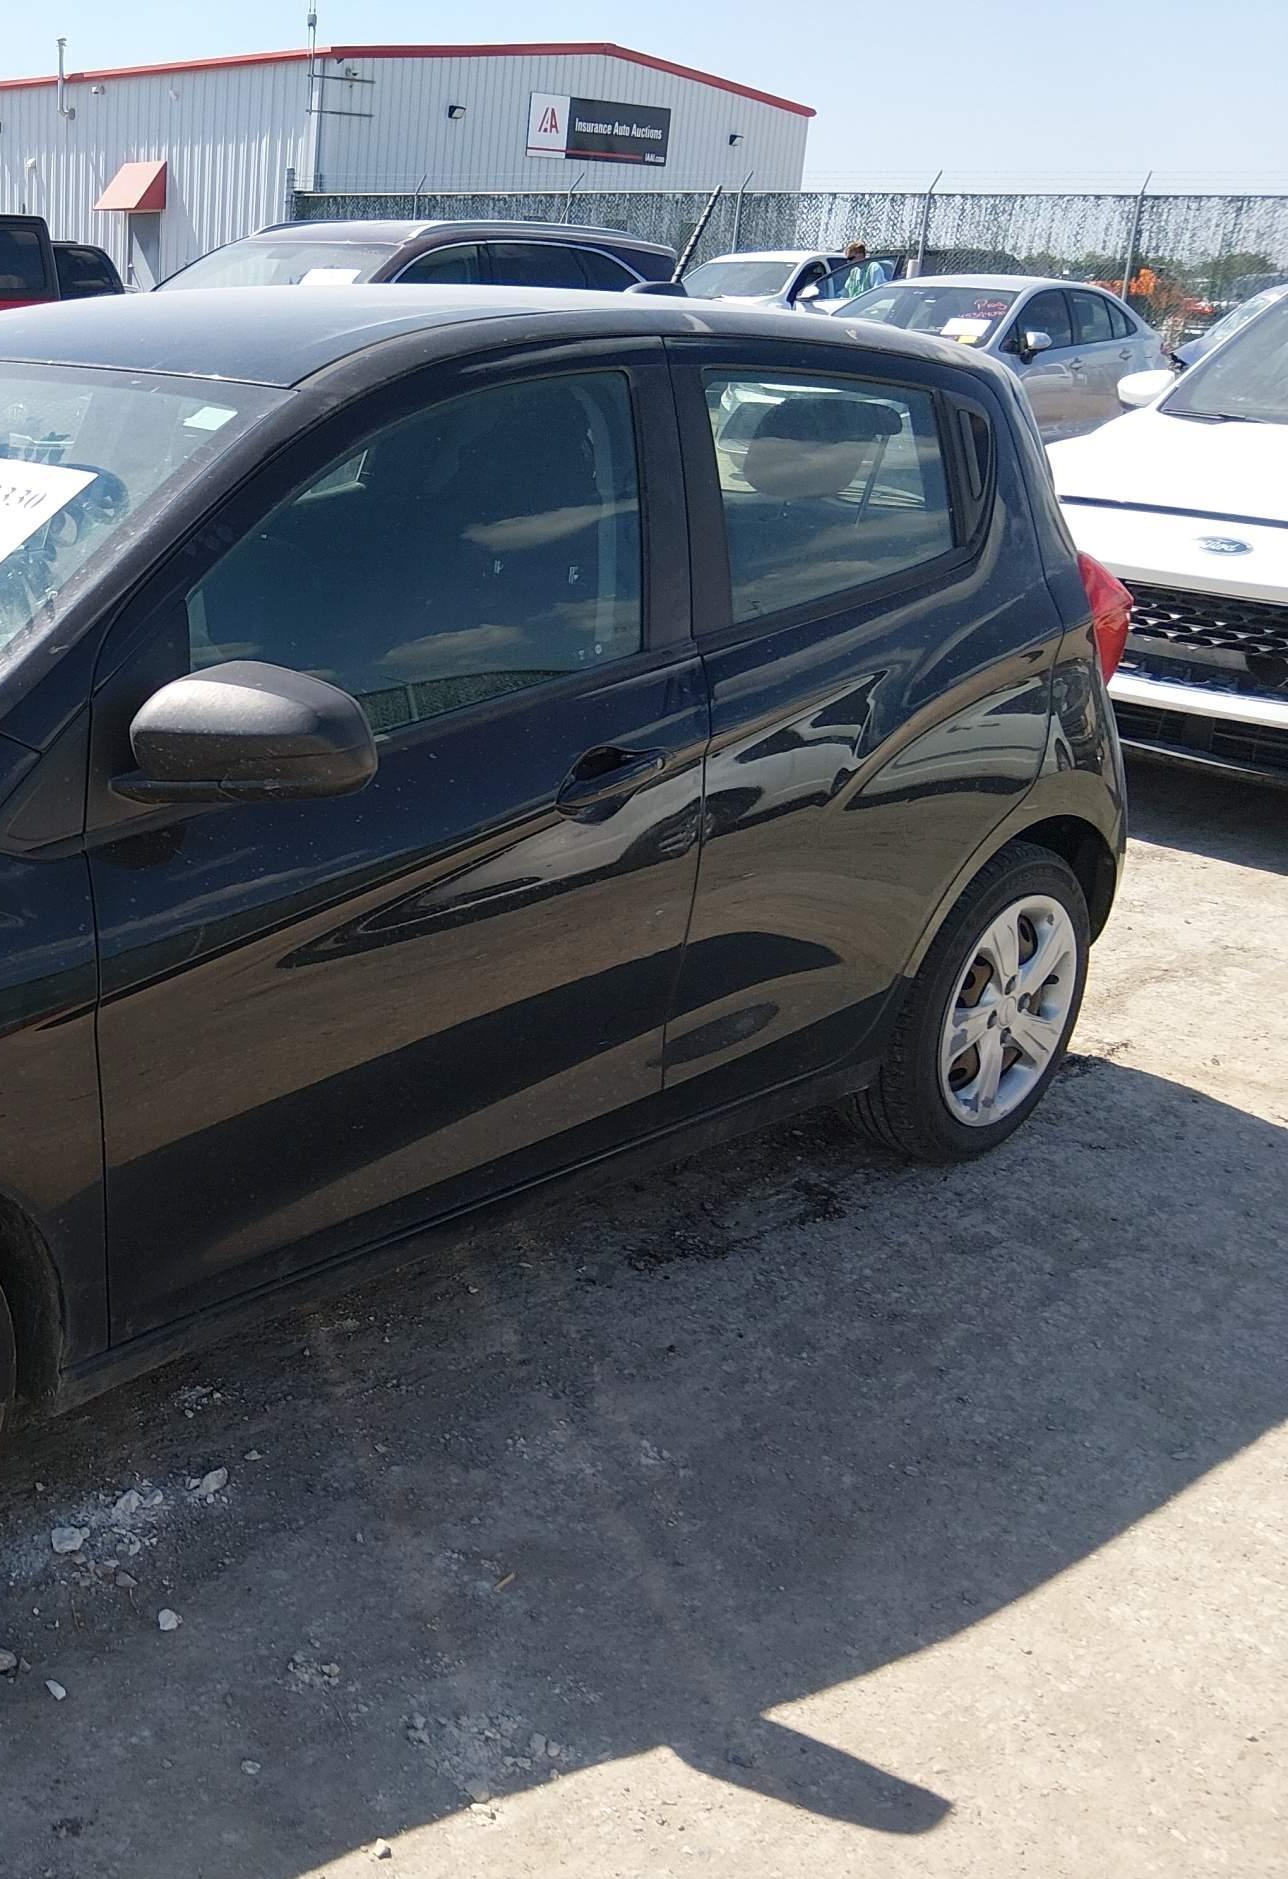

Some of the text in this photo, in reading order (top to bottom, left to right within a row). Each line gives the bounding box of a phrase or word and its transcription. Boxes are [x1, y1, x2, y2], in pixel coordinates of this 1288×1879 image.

[575, 117, 663, 140] Insurance Auto Auctions
